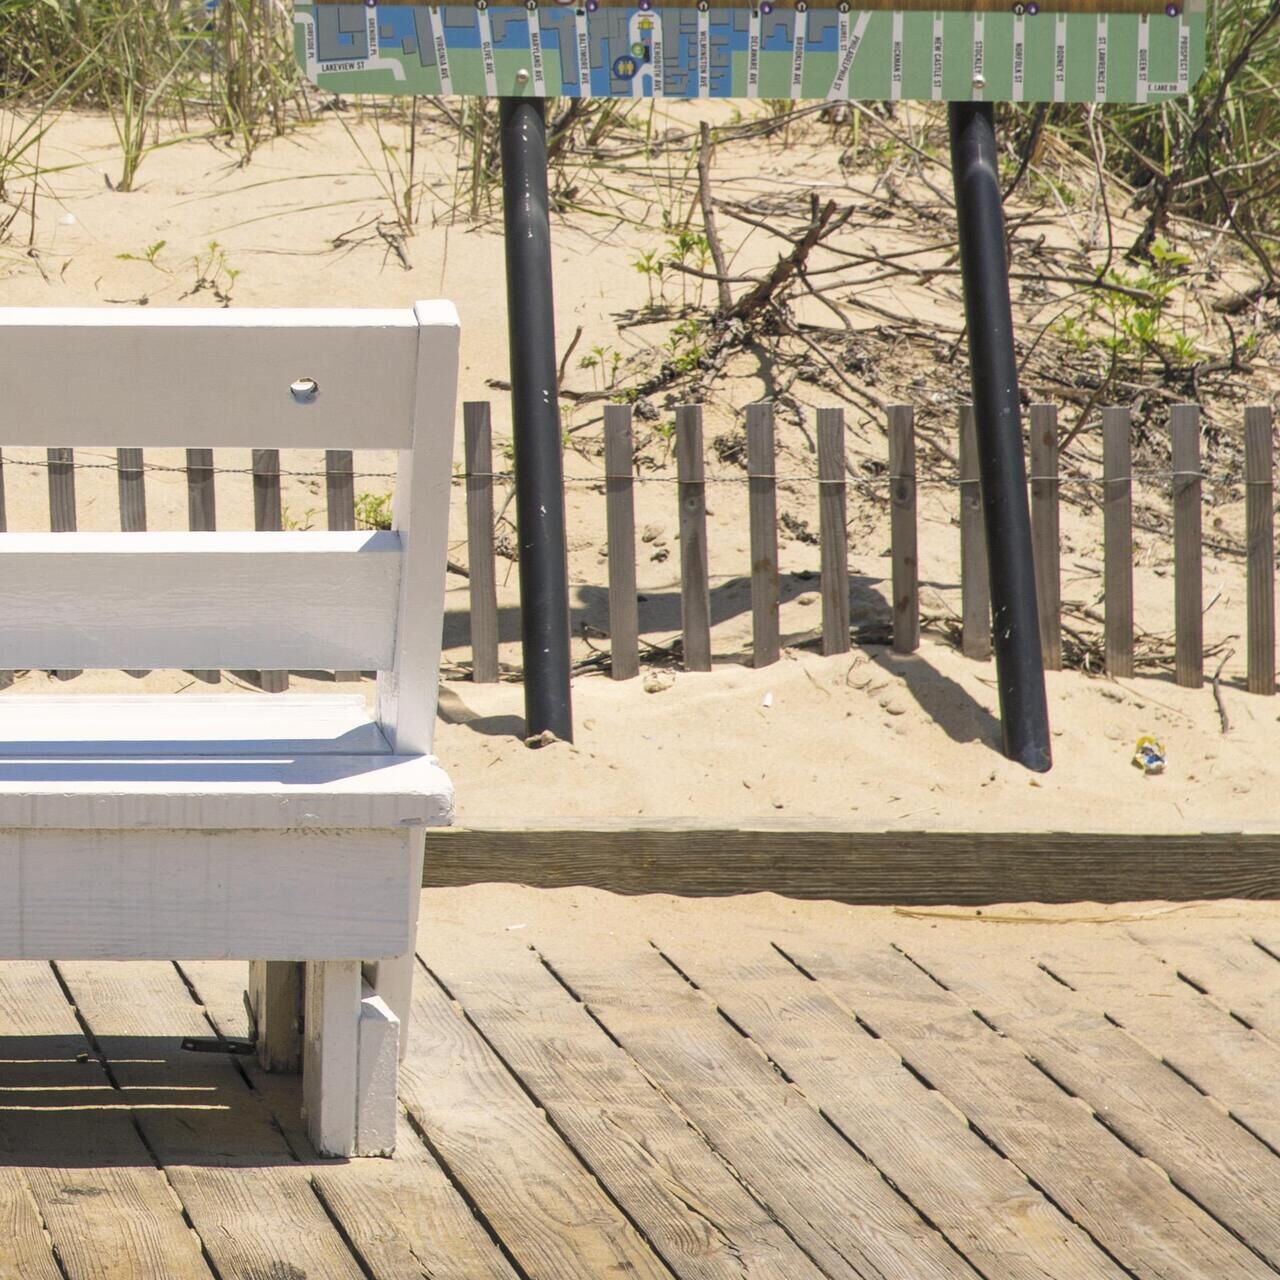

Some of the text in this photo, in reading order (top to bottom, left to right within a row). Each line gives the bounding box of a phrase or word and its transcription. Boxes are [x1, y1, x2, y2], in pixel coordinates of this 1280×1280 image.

[436, 36, 449, 80] VIRGINIA AVE
[483, 42, 494, 74] OLIVE AVE
[532, 32, 542, 68] MARYLAND
[749, 36, 758, 84] DELAWARE AVE
[322, 63, 352, 72] LAKEVIEW
[1014, 75, 1022, 83] ST
[934, 80, 941, 88] ST
